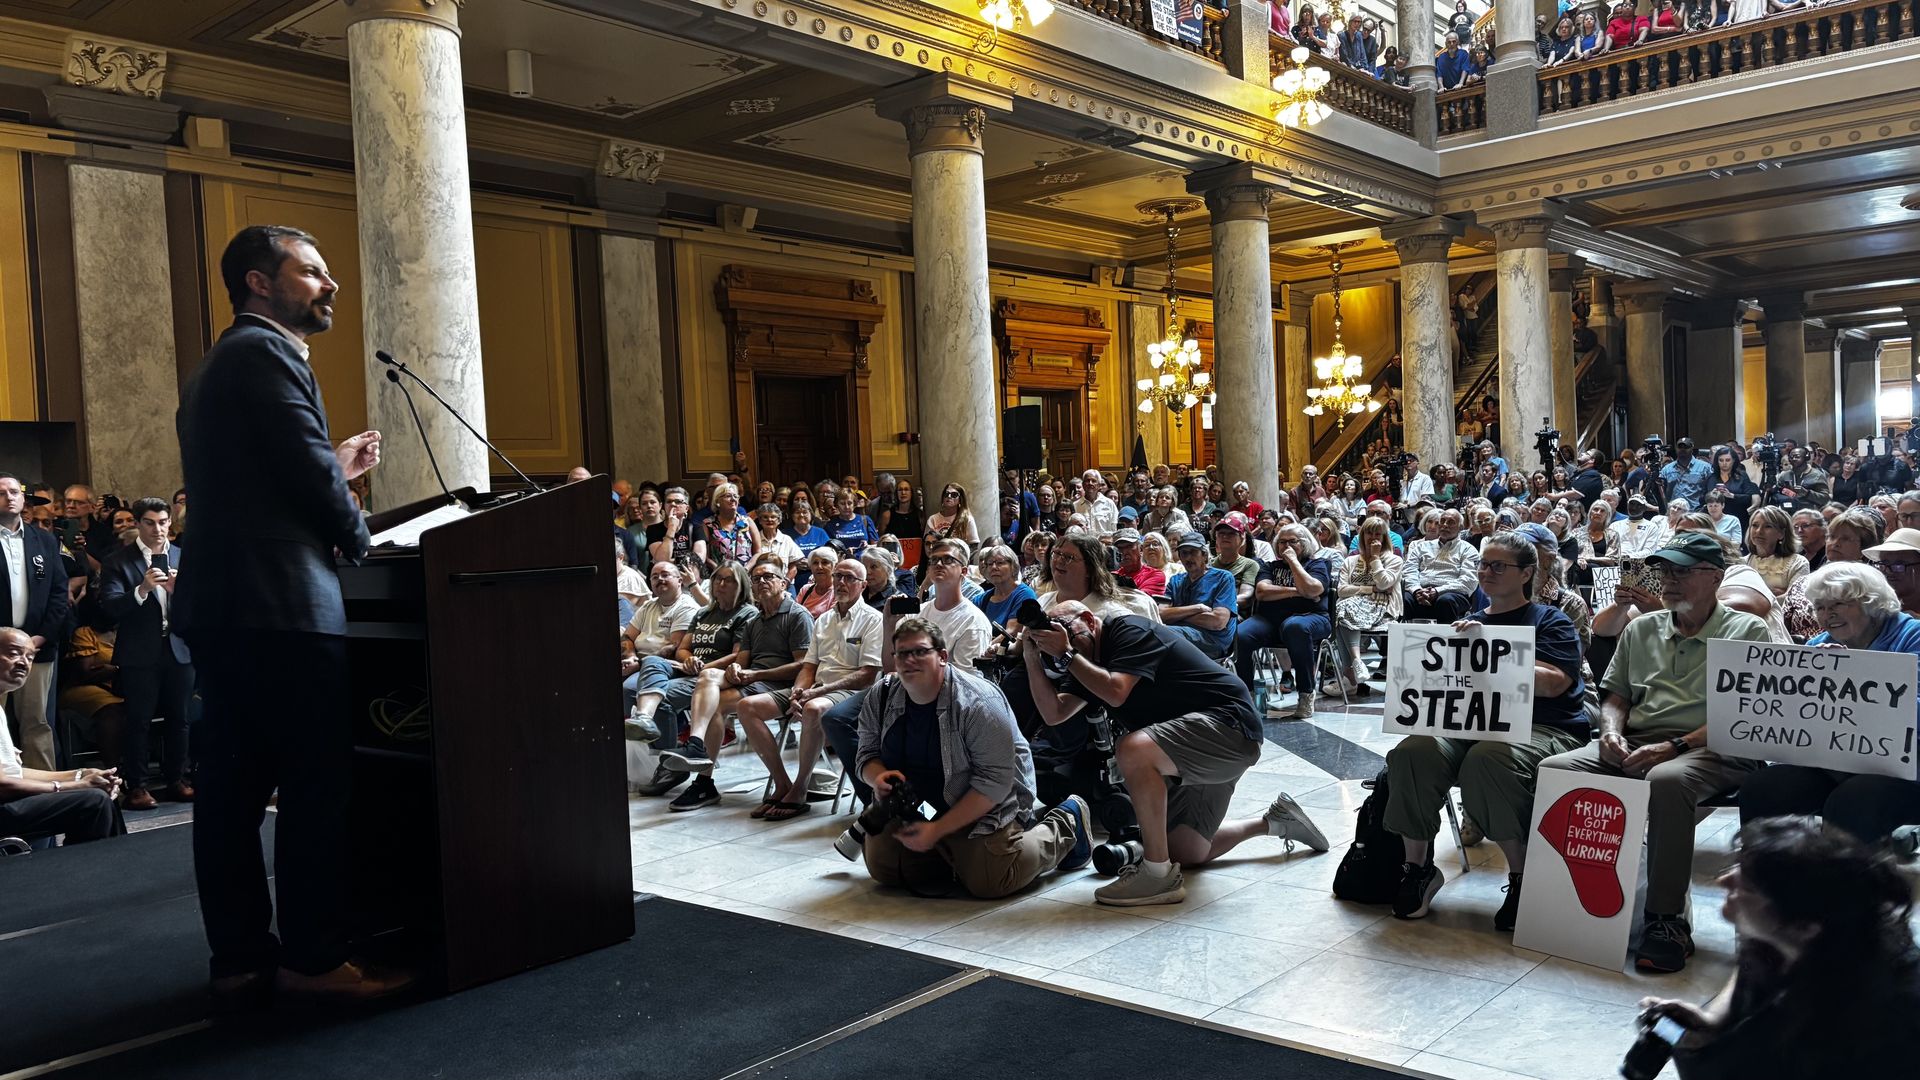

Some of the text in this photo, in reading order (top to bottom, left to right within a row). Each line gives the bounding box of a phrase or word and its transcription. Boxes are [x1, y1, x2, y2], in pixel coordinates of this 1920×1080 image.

[1421, 636, 1512, 674] STOP
[1746, 645, 1851, 671] PROTECT
[1443, 674, 1474, 689] THE
[1716, 669, 1909, 709] DEMOCRACY
[1395, 688, 1512, 732] STEAL
[1738, 697, 1858, 727] FOR OUR
[1729, 720, 1813, 748] GRAND
[1567, 825, 1622, 846] EVERYTHING
[1583, 816, 1609, 831] GOT
[1566, 841, 1618, 865] WRONG!
